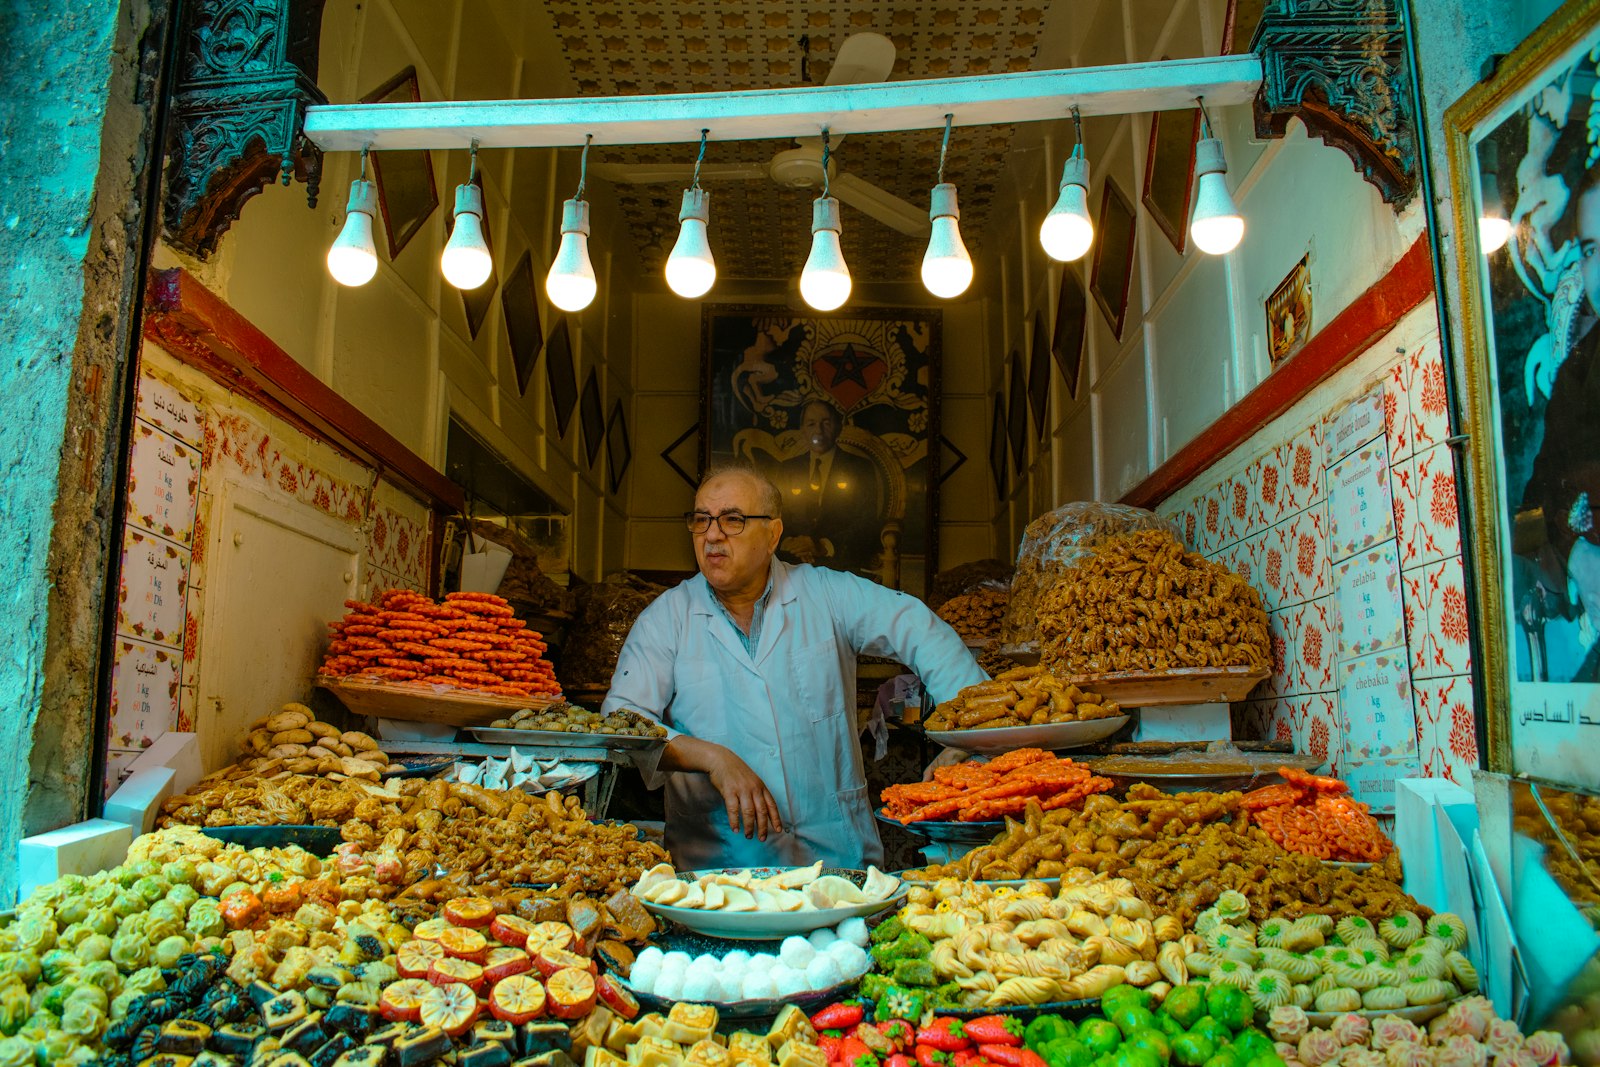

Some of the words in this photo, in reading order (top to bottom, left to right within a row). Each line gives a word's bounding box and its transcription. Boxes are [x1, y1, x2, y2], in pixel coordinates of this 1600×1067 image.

[153, 392, 165, 410] دنيا
[167, 403, 188, 423] حلويات
[164, 473, 172, 488] kg
[154, 576, 162, 592] kg
[1352, 569, 1377, 588] zelabia
[154, 594, 162, 607] Dh
[1362, 592, 1371, 604] kg
[1365, 607, 1375, 619] Dh
[1356, 672, 1389, 690] chebakia
[141, 683, 149, 698] kg
[141, 701, 150, 713] Dh
[1371, 696, 1381, 708] kg
[1375, 711, 1386, 723] Dh
[1519, 699, 1574, 726] السادس
